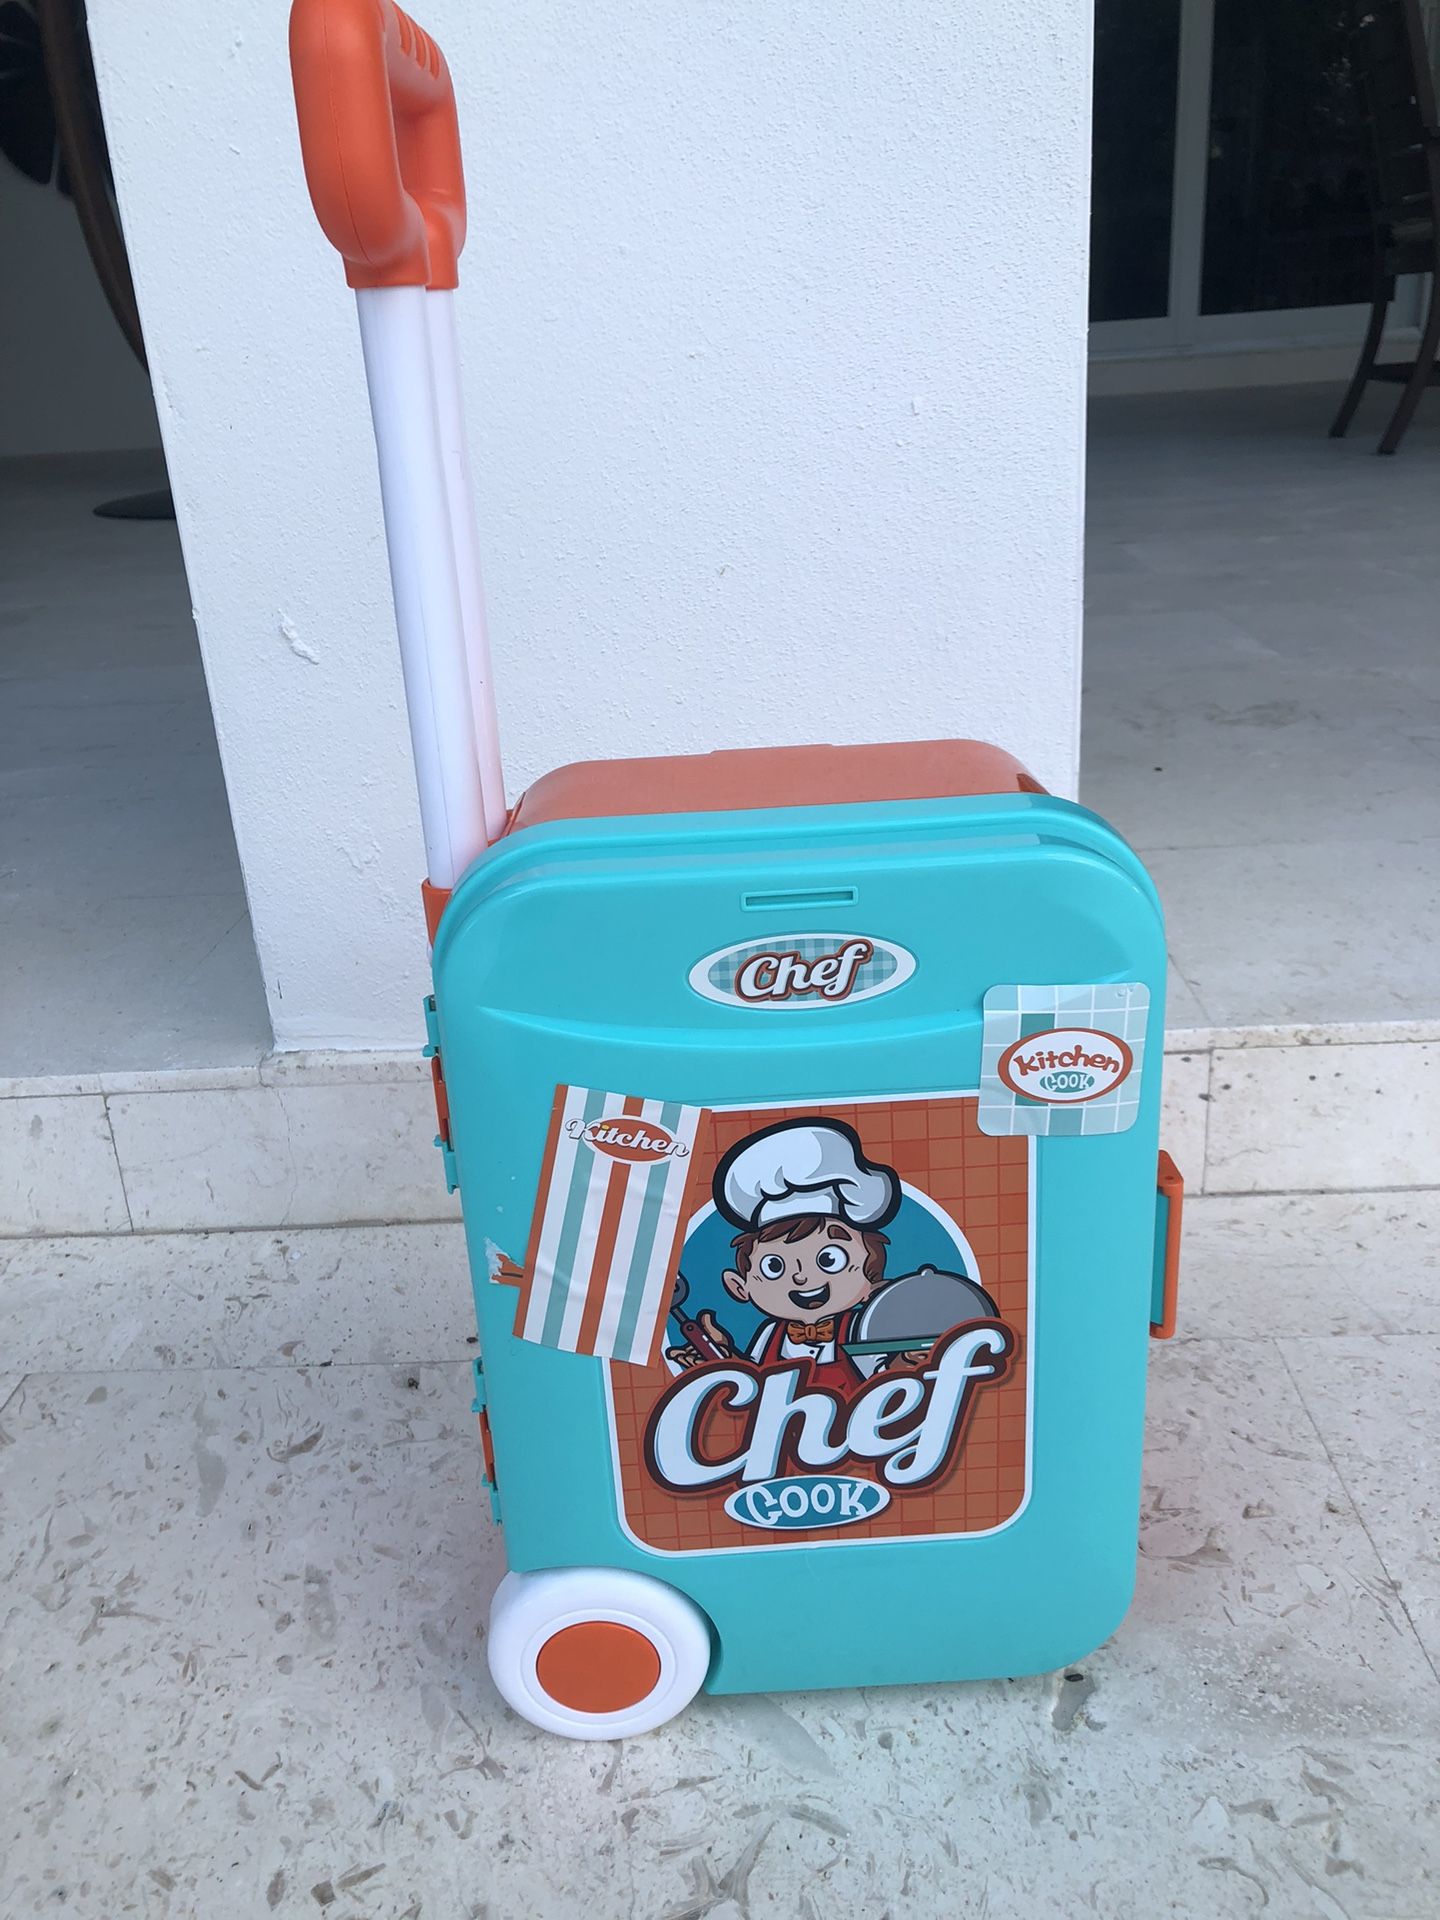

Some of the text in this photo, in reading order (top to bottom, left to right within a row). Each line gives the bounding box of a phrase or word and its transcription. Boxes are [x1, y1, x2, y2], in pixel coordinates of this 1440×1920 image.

[737, 940, 871, 999] Chef
[1012, 1044, 1120, 1076] Kitchen
[1044, 1073, 1095, 1092] COOK
[564, 1117, 690, 1157] Kitchen
[649, 1324, 1009, 1490] Chef
[745, 1482, 870, 1525] COOK
